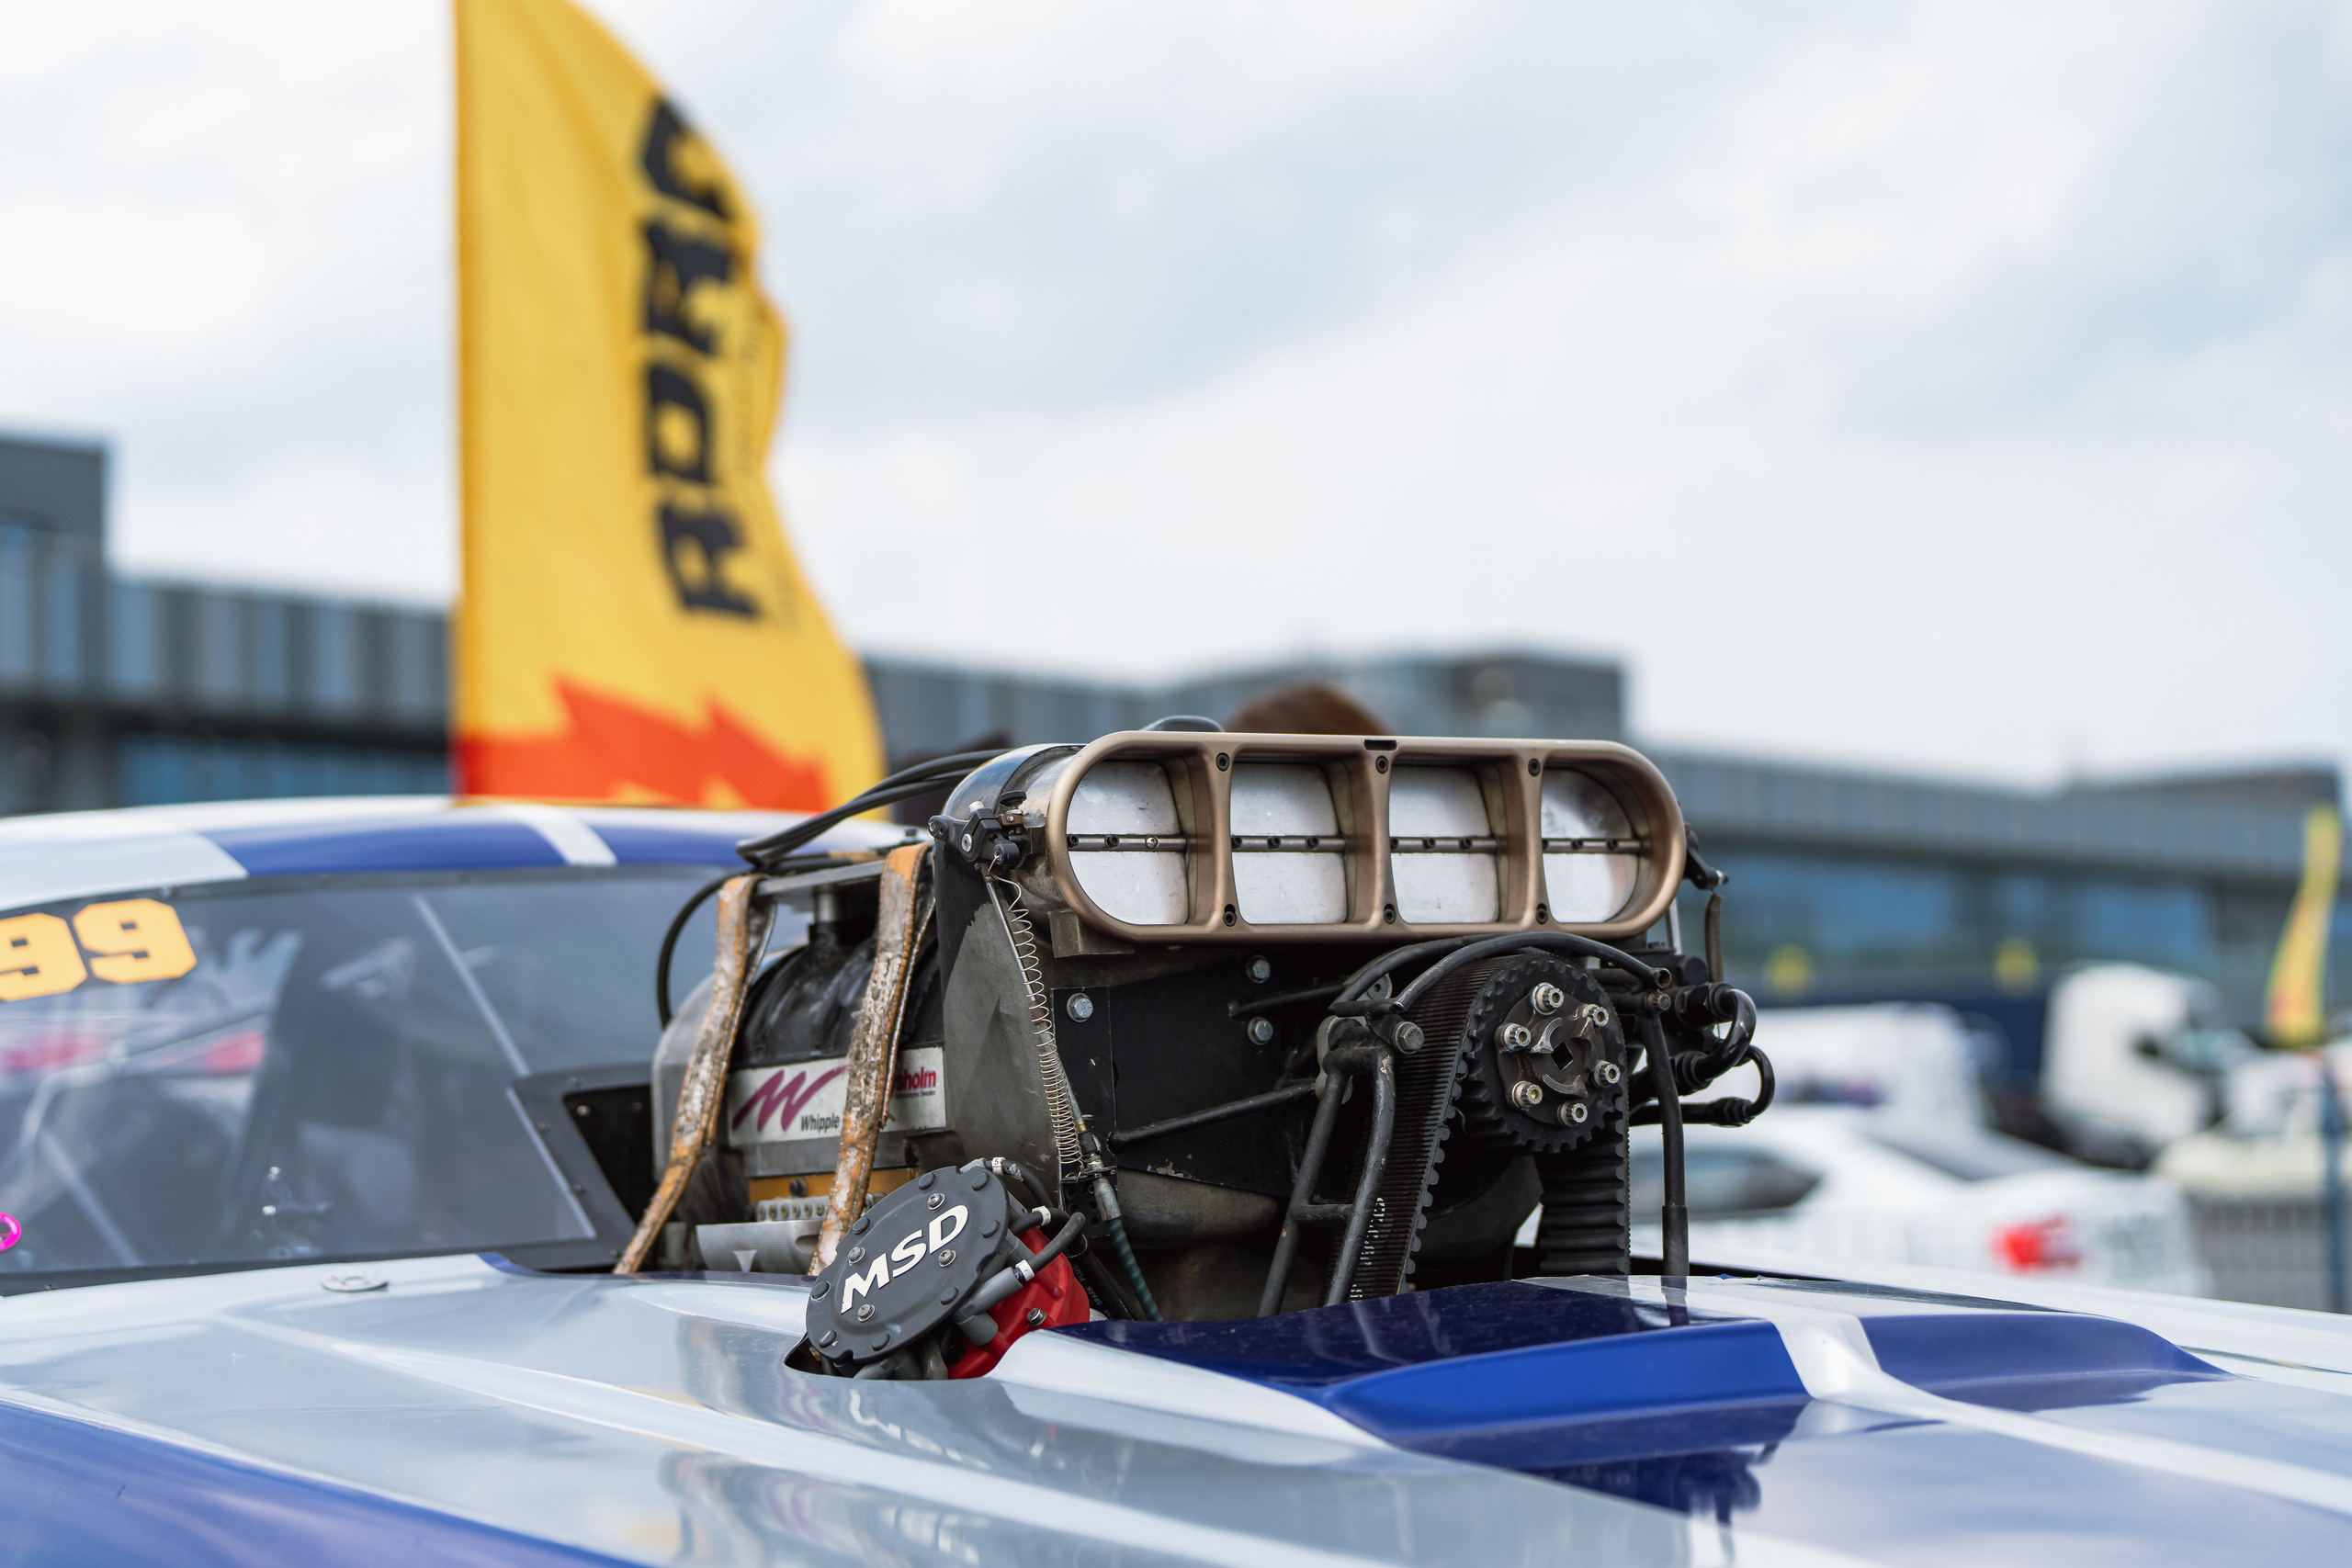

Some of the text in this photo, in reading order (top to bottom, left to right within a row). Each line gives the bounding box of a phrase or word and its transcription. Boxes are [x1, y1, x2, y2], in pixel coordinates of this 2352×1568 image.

[0, 898, 198, 1001] 99
[892, 1066, 937, 1093] sholm
[800, 1112, 840, 1134] Whipple
[841, 1204, 969, 1314] MSD
[1073, 1265, 1086, 1282] PLUG
[1085, 1285, 1103, 1306] SPARK
